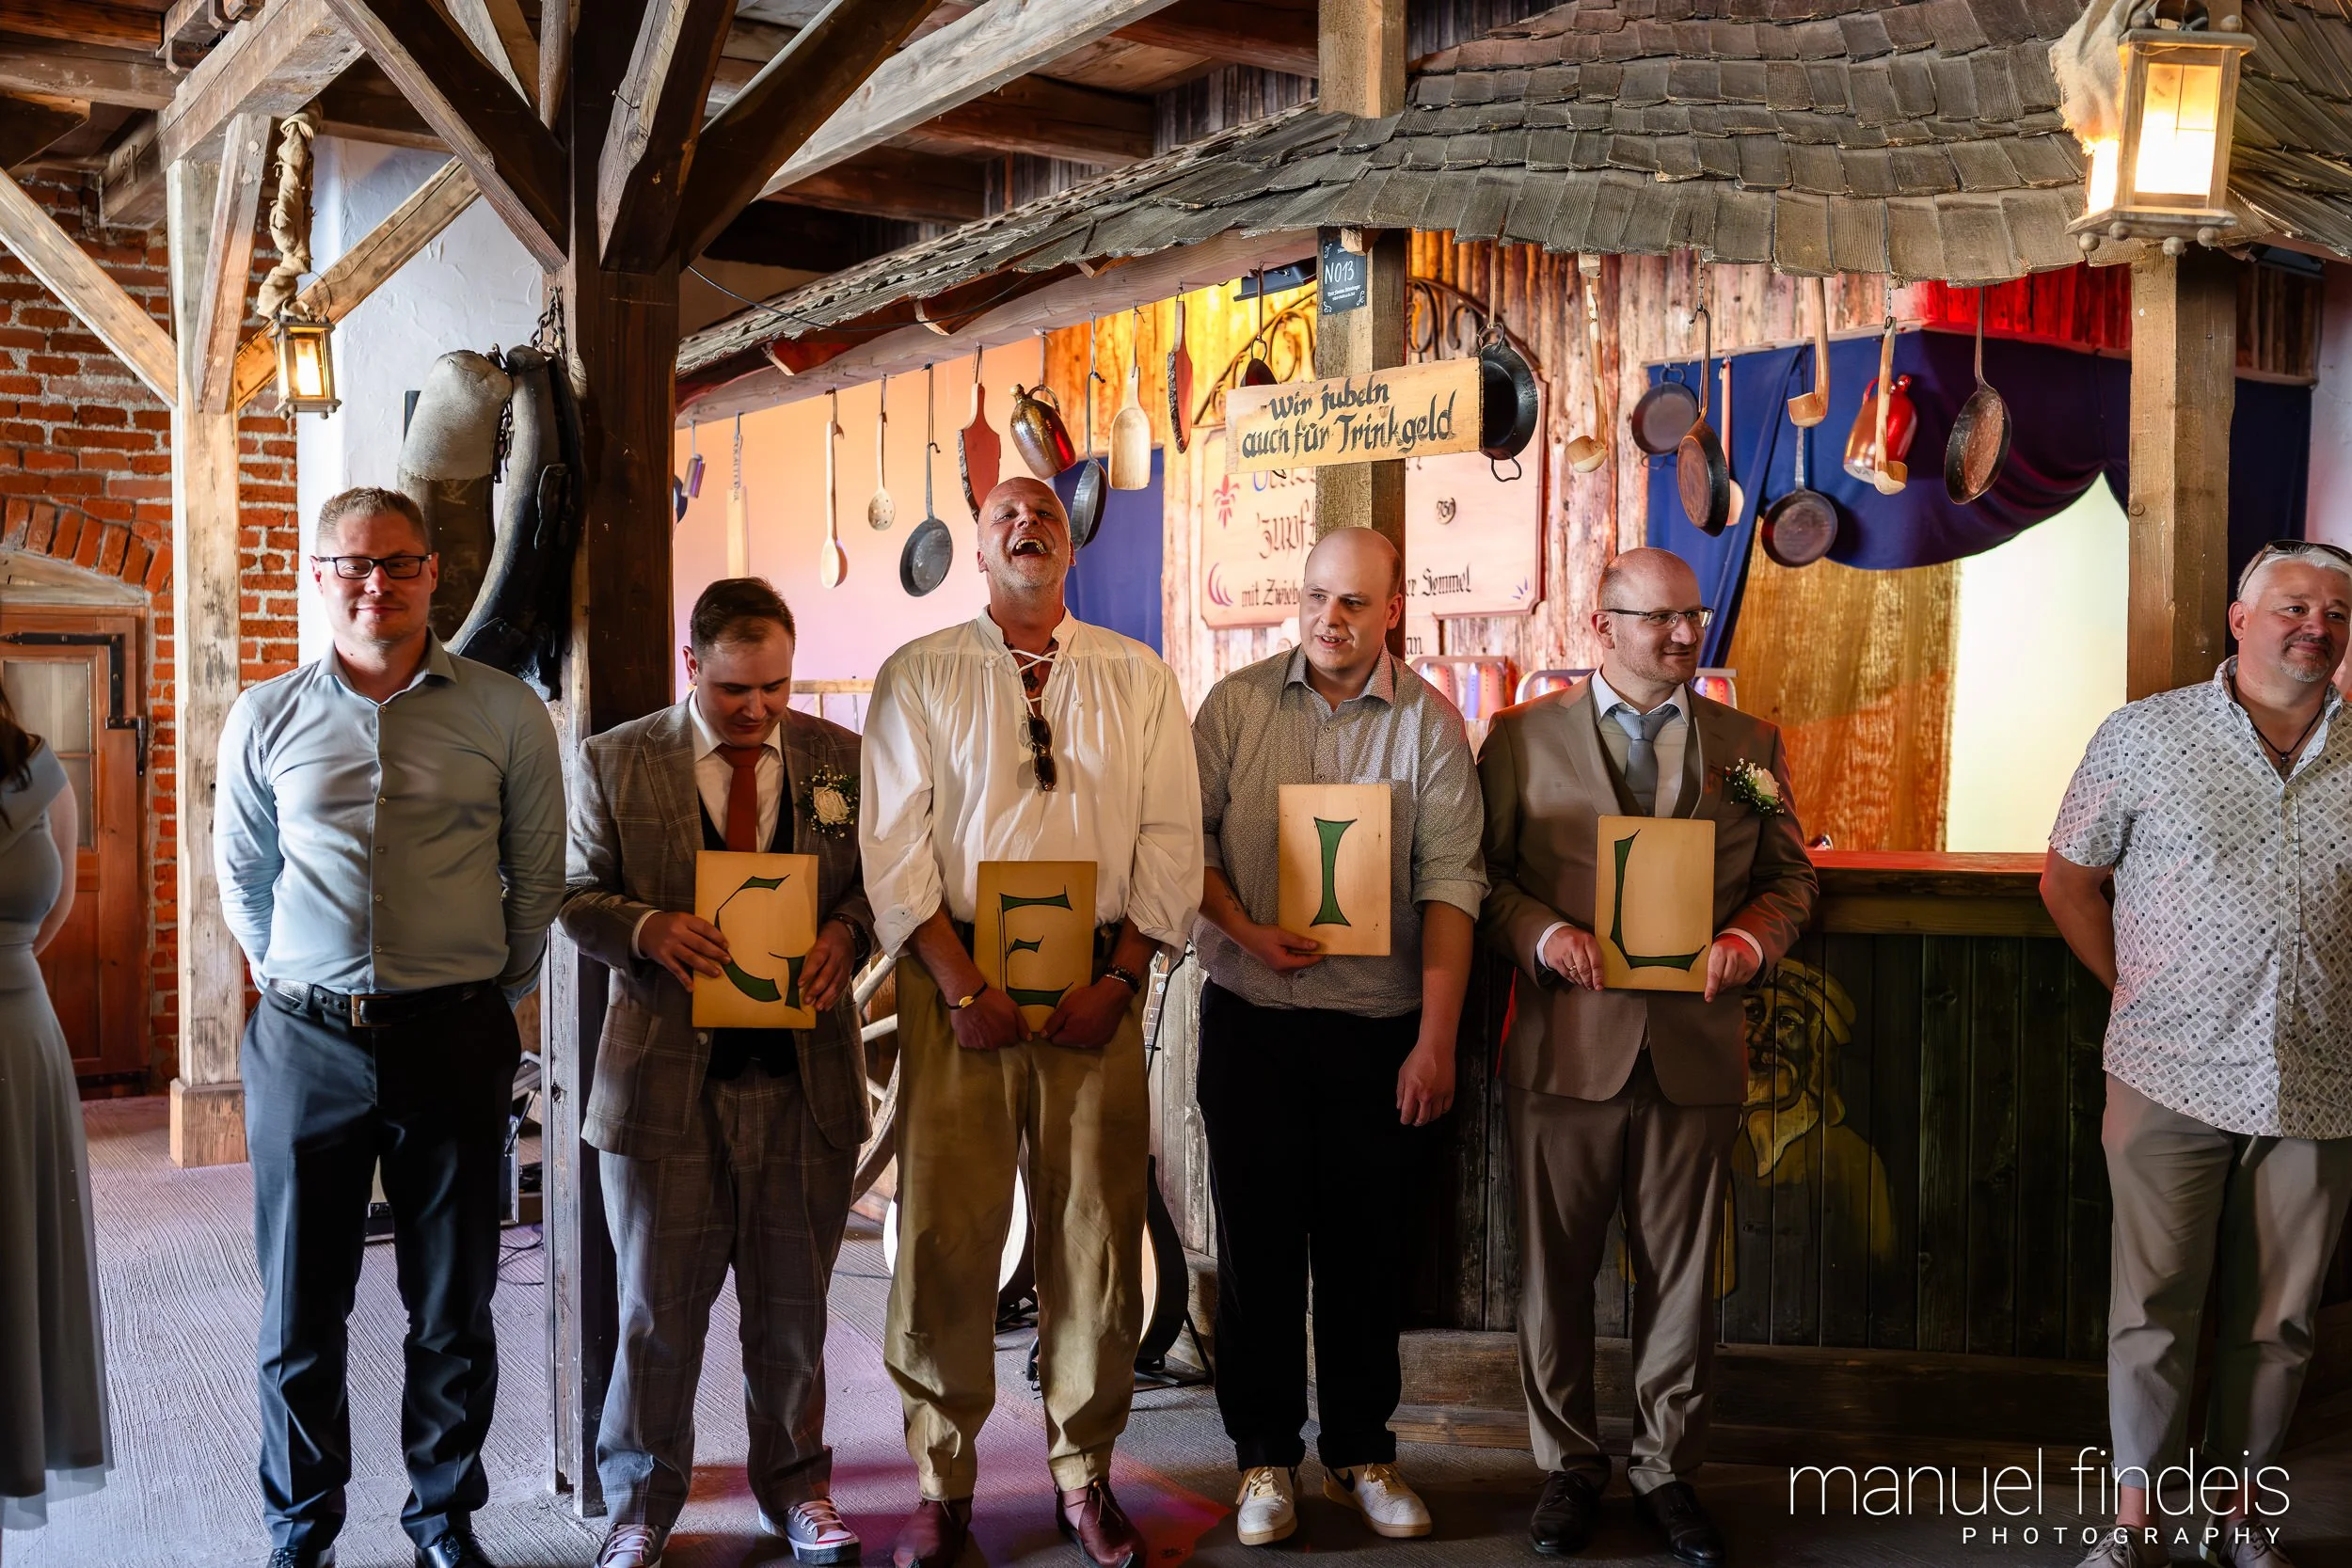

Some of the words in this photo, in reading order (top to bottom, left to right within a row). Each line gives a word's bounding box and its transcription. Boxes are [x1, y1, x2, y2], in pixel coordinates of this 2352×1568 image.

[1242, 420, 1290, 458] auch
[1293, 416, 1329, 459] für
[1333, 388, 1457, 454] Trinkgeld
[1319, 375, 1391, 420] jubeln
[1241, 579, 1260, 608] mit
[1262, 578, 1301, 606] Zwieb
[1422, 562, 1472, 596] Semmel
[1310, 816, 1358, 927] I
[1610, 829, 1707, 972] L
[997, 884, 1073, 1007] E
